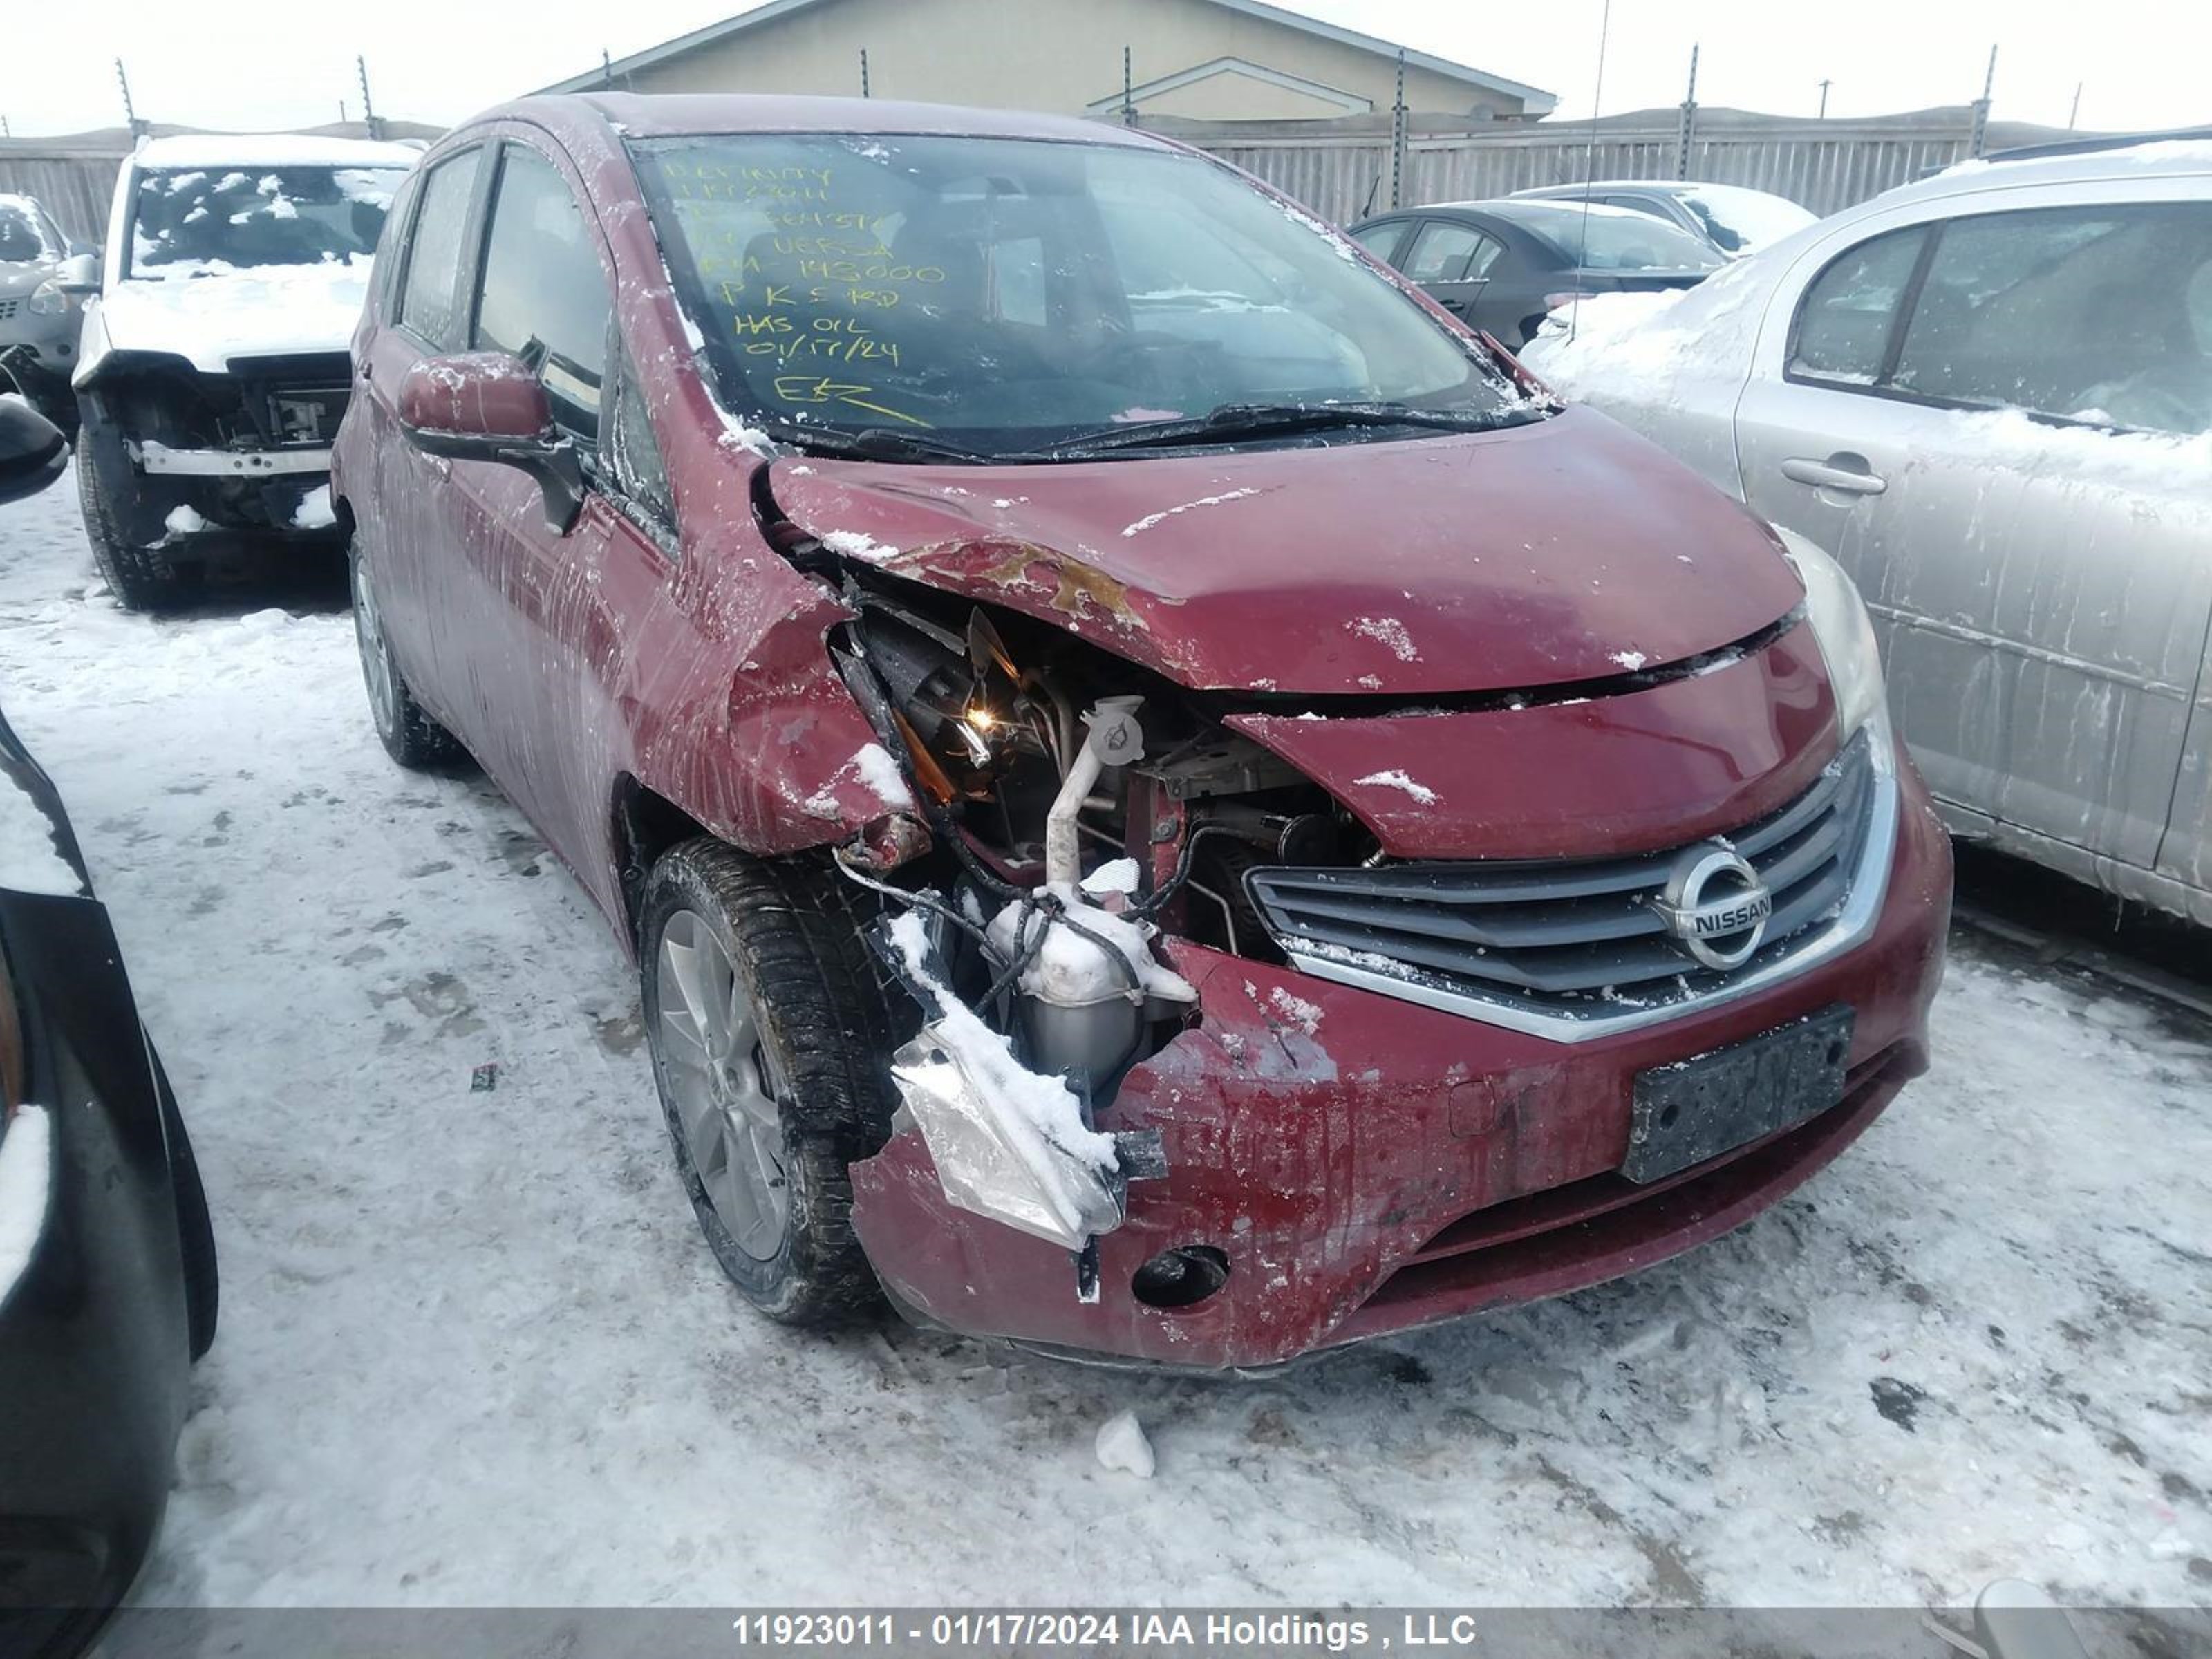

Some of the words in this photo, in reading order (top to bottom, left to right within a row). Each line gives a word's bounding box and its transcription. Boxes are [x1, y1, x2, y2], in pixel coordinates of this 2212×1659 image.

[735, 314, 794, 335] HAS
[813, 318, 873, 334] OIL
[742, 333, 899, 368] 01/17/24
[1696, 896, 1770, 933] NISSAN
